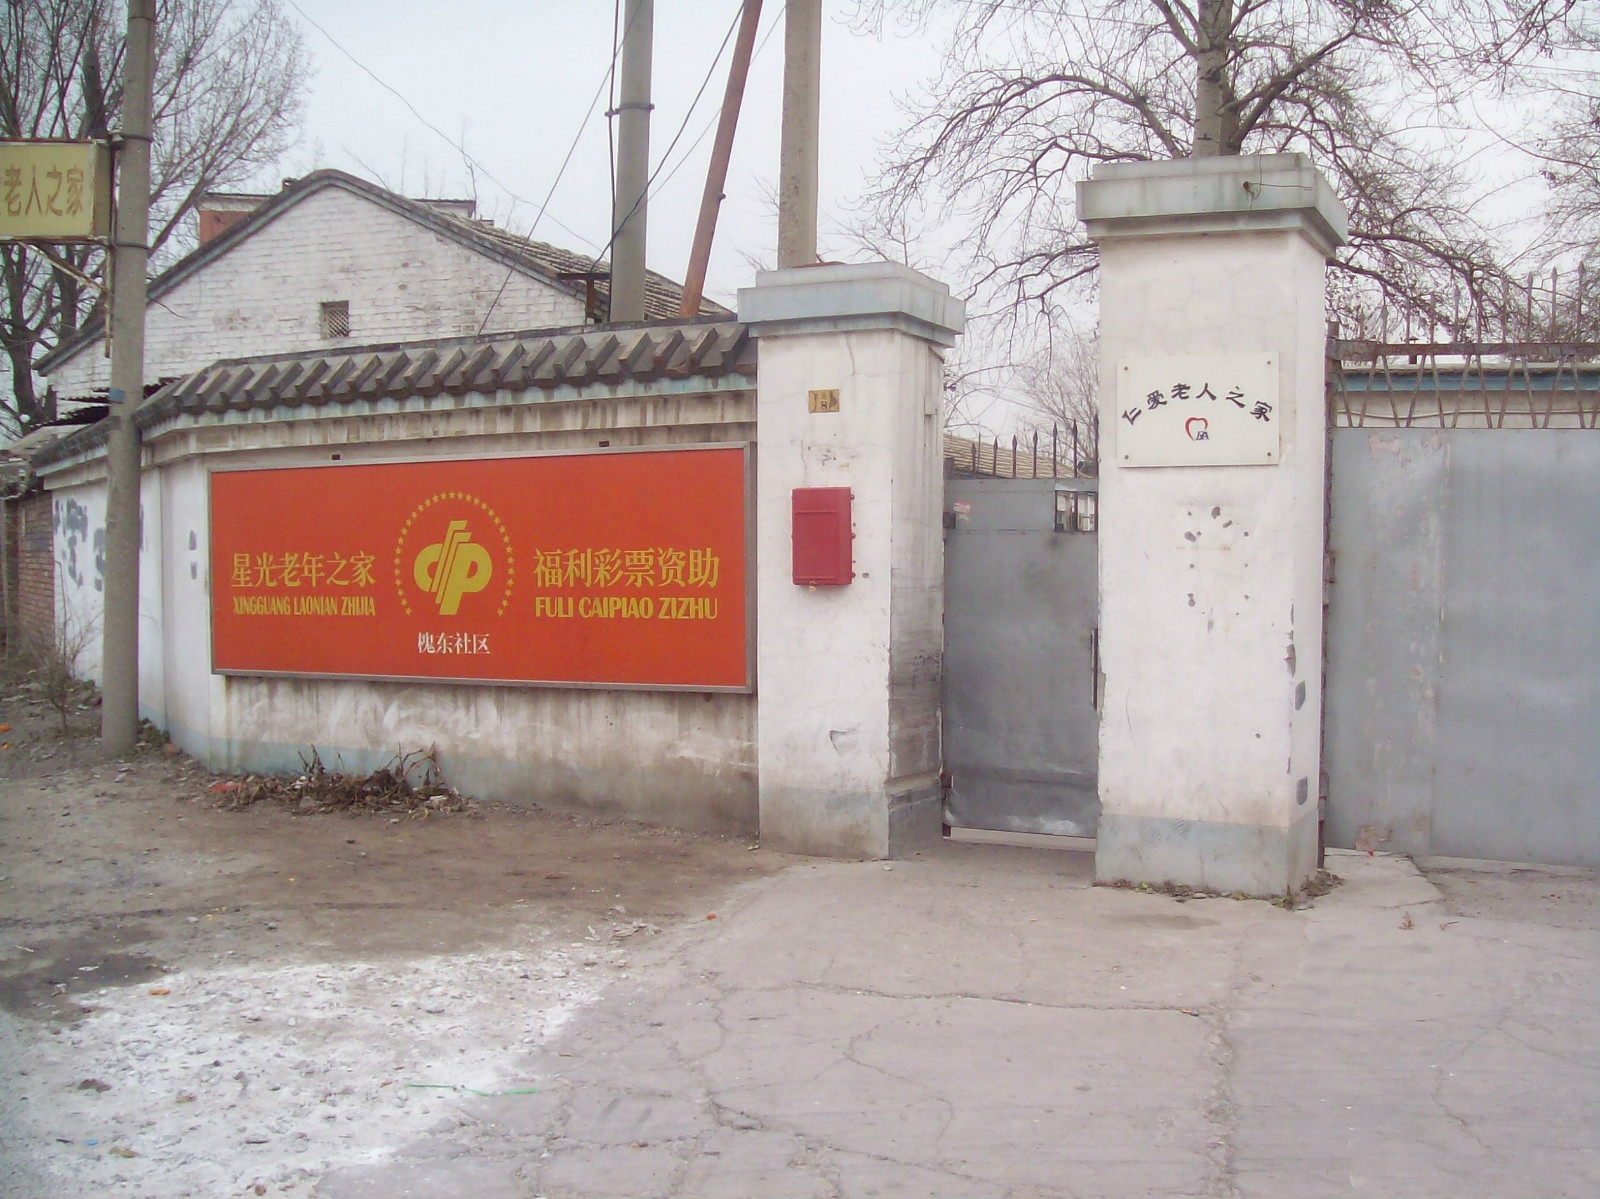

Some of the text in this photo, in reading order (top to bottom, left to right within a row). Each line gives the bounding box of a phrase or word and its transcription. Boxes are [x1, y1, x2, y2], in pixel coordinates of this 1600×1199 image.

[0, 164, 84, 217] 老人之家
[1121, 382, 1273, 426] 仁爱老人之家
[230, 550, 376, 588] 星光老年之家
[532, 547, 720, 588] 福利彩票资助
[233, 595, 376, 617] XINGGUANG LAONIAN ZHIJIA
[535, 597, 719, 620] FULI CAIPIAO ZIZHU
